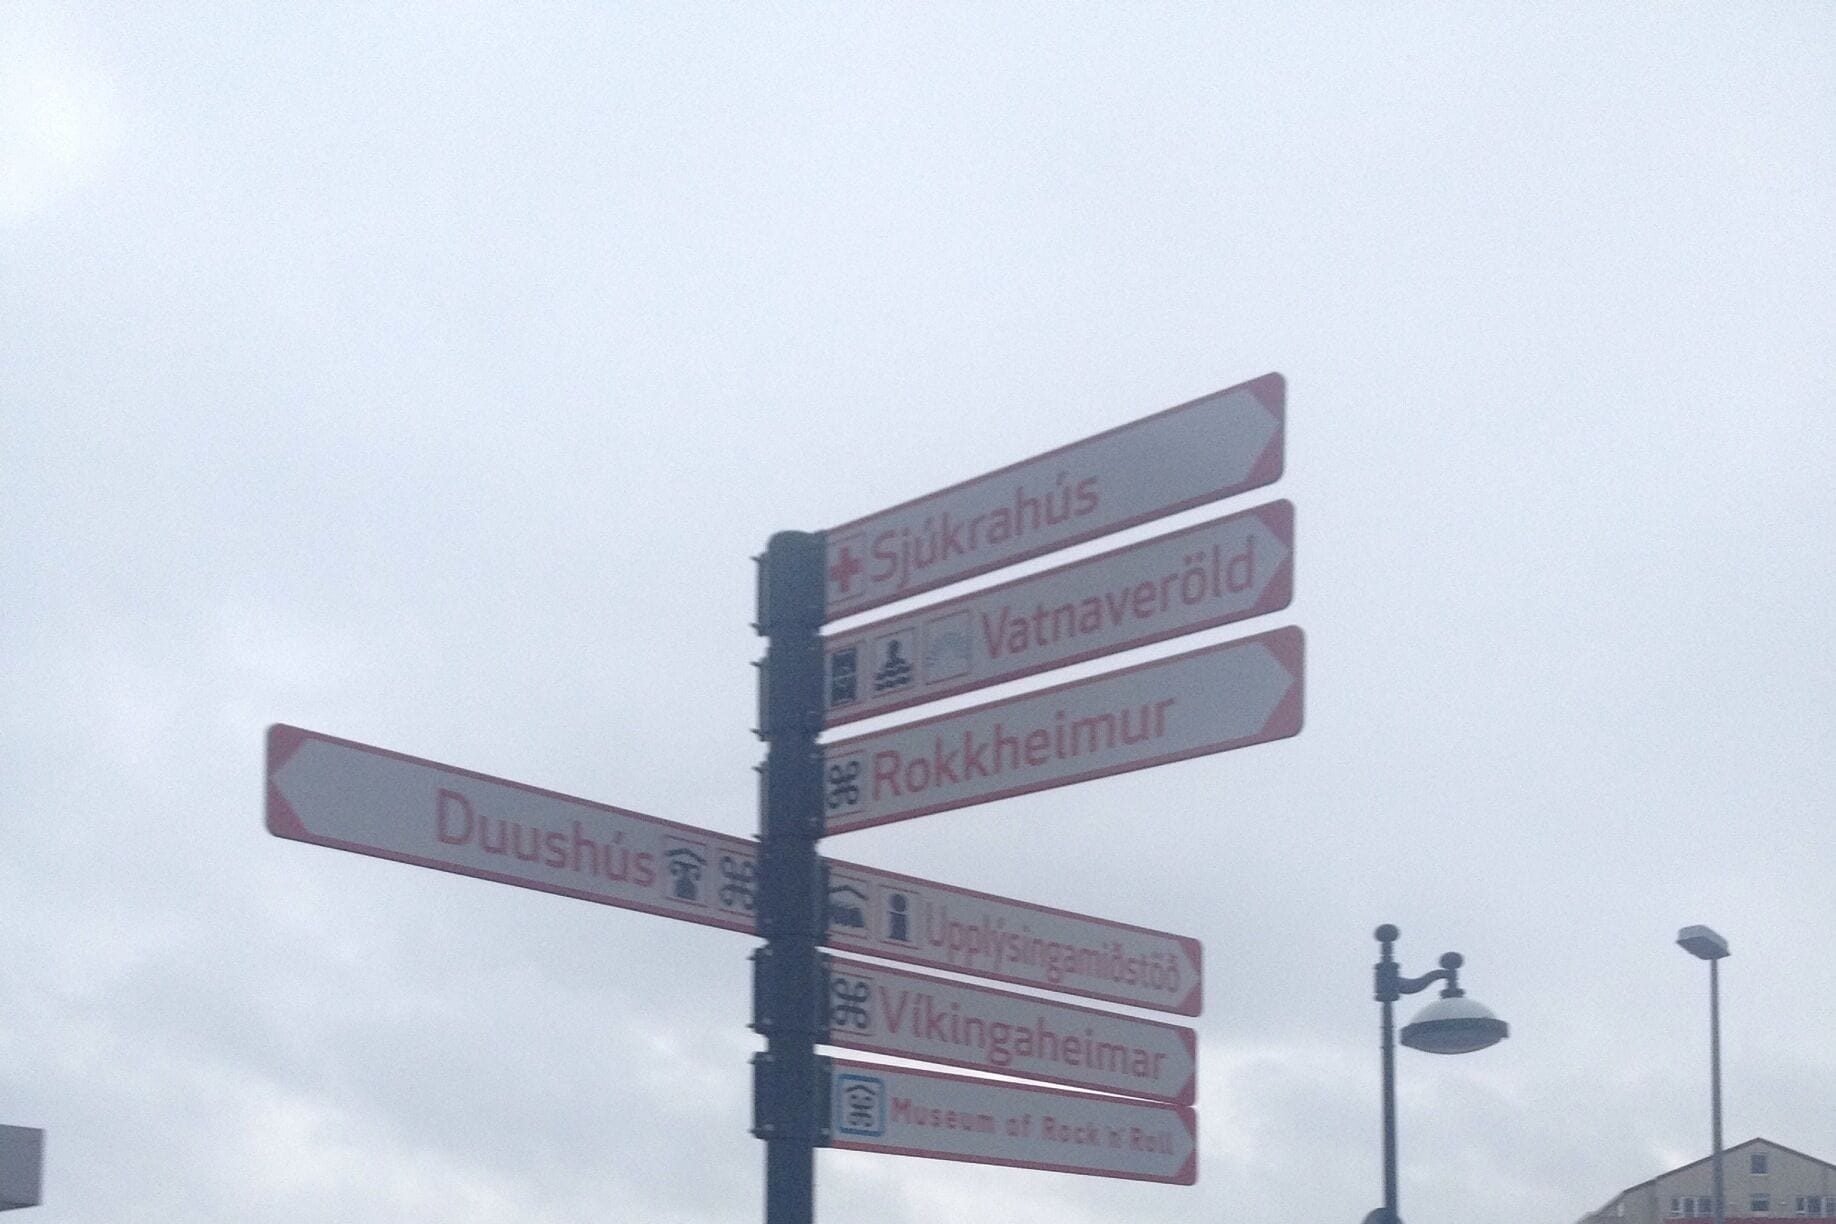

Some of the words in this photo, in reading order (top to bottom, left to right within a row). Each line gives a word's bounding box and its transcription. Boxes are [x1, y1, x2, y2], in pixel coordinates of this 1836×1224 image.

[870, 473, 1099, 588] Sjúkrahús
[979, 536, 1256, 660] Vatnaveröld
[872, 699, 1175, 800] Rokkheimur
[437, 788, 656, 887] Duushús
[891, 1097, 996, 1134] Museum
[1006, 1114, 1032, 1138] of
